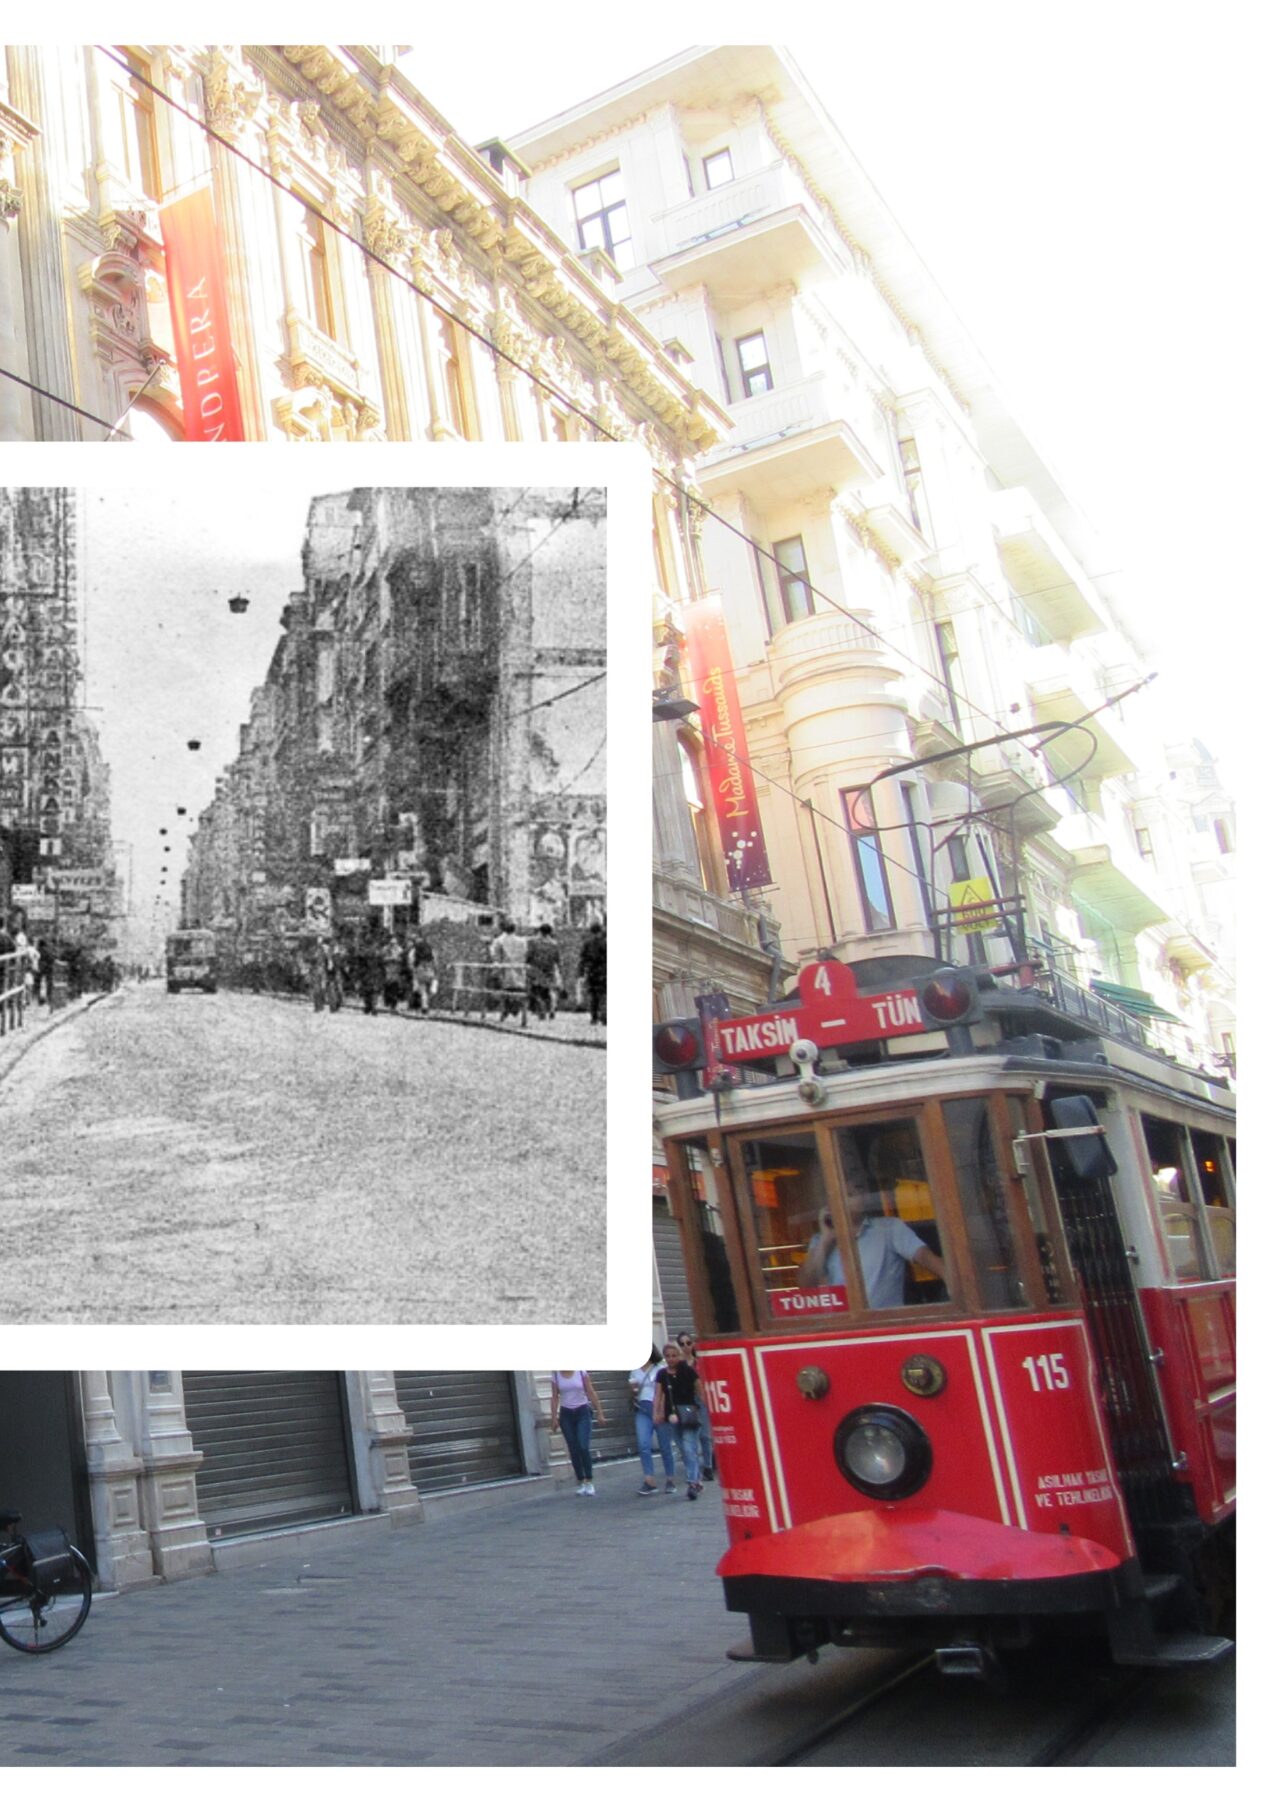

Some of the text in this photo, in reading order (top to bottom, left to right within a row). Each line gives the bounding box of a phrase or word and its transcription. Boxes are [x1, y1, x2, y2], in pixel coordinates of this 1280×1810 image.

[703, 665, 750, 818] Madame Tussauds
[813, 966, 832, 996] 4
[721, 1015, 799, 1054] TAKSİM
[871, 993, 922, 1029] TÜN
[780, 1292, 843, 1311] TÜNEL
[1022, 1353, 1070, 1391] 115
